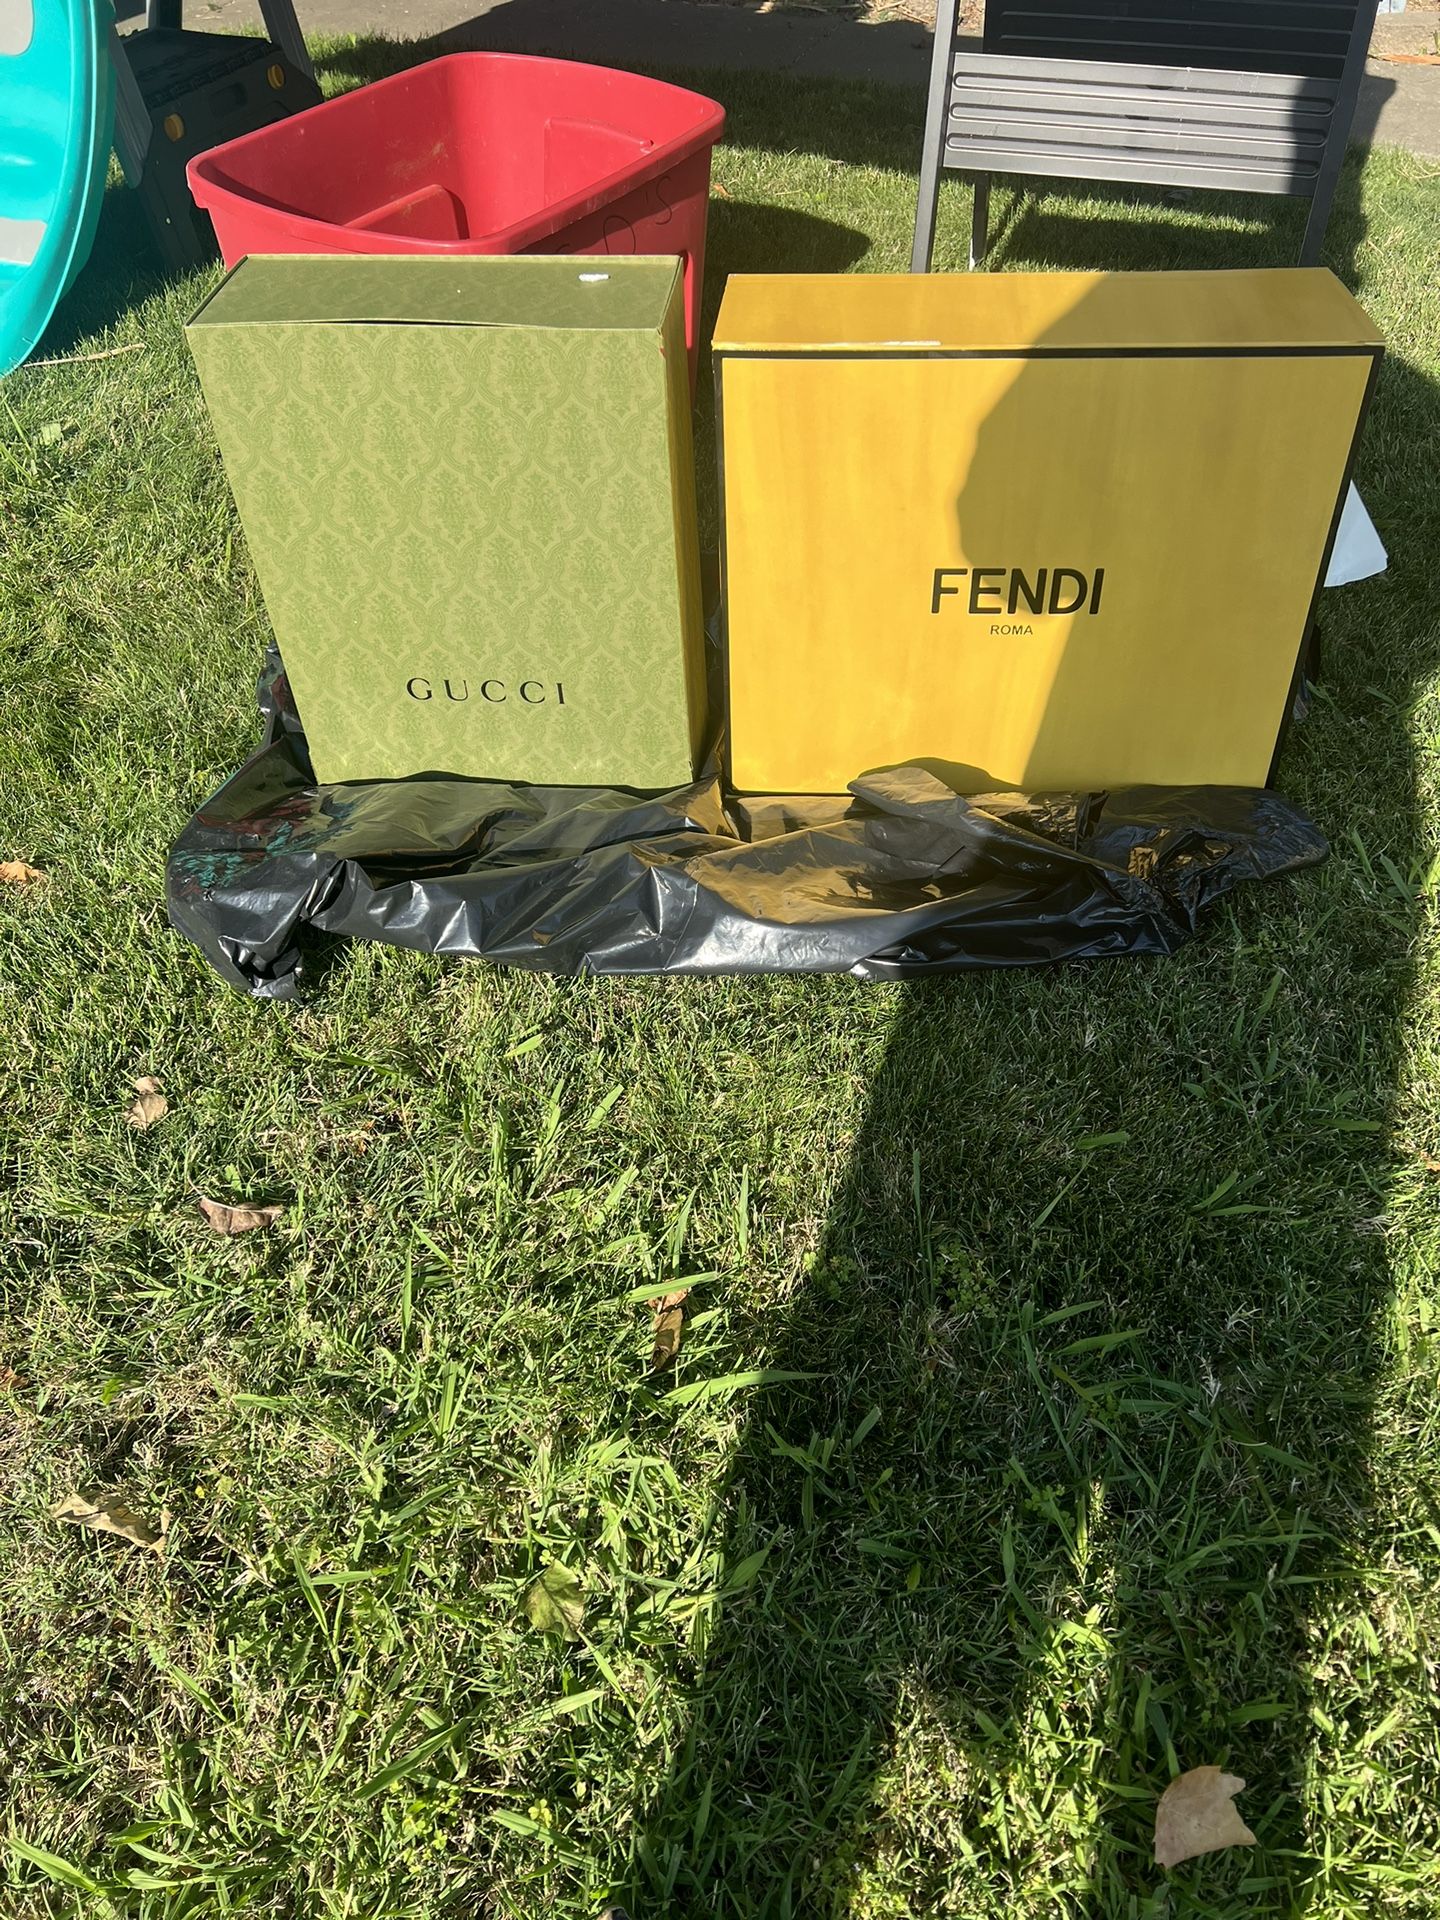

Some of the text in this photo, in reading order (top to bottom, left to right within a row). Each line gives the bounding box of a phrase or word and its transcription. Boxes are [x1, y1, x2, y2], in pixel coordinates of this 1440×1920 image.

[931, 568, 1105, 615] FENDI
[990, 624, 1034, 636] ROMA
[406, 677, 565, 705] GUCCI
